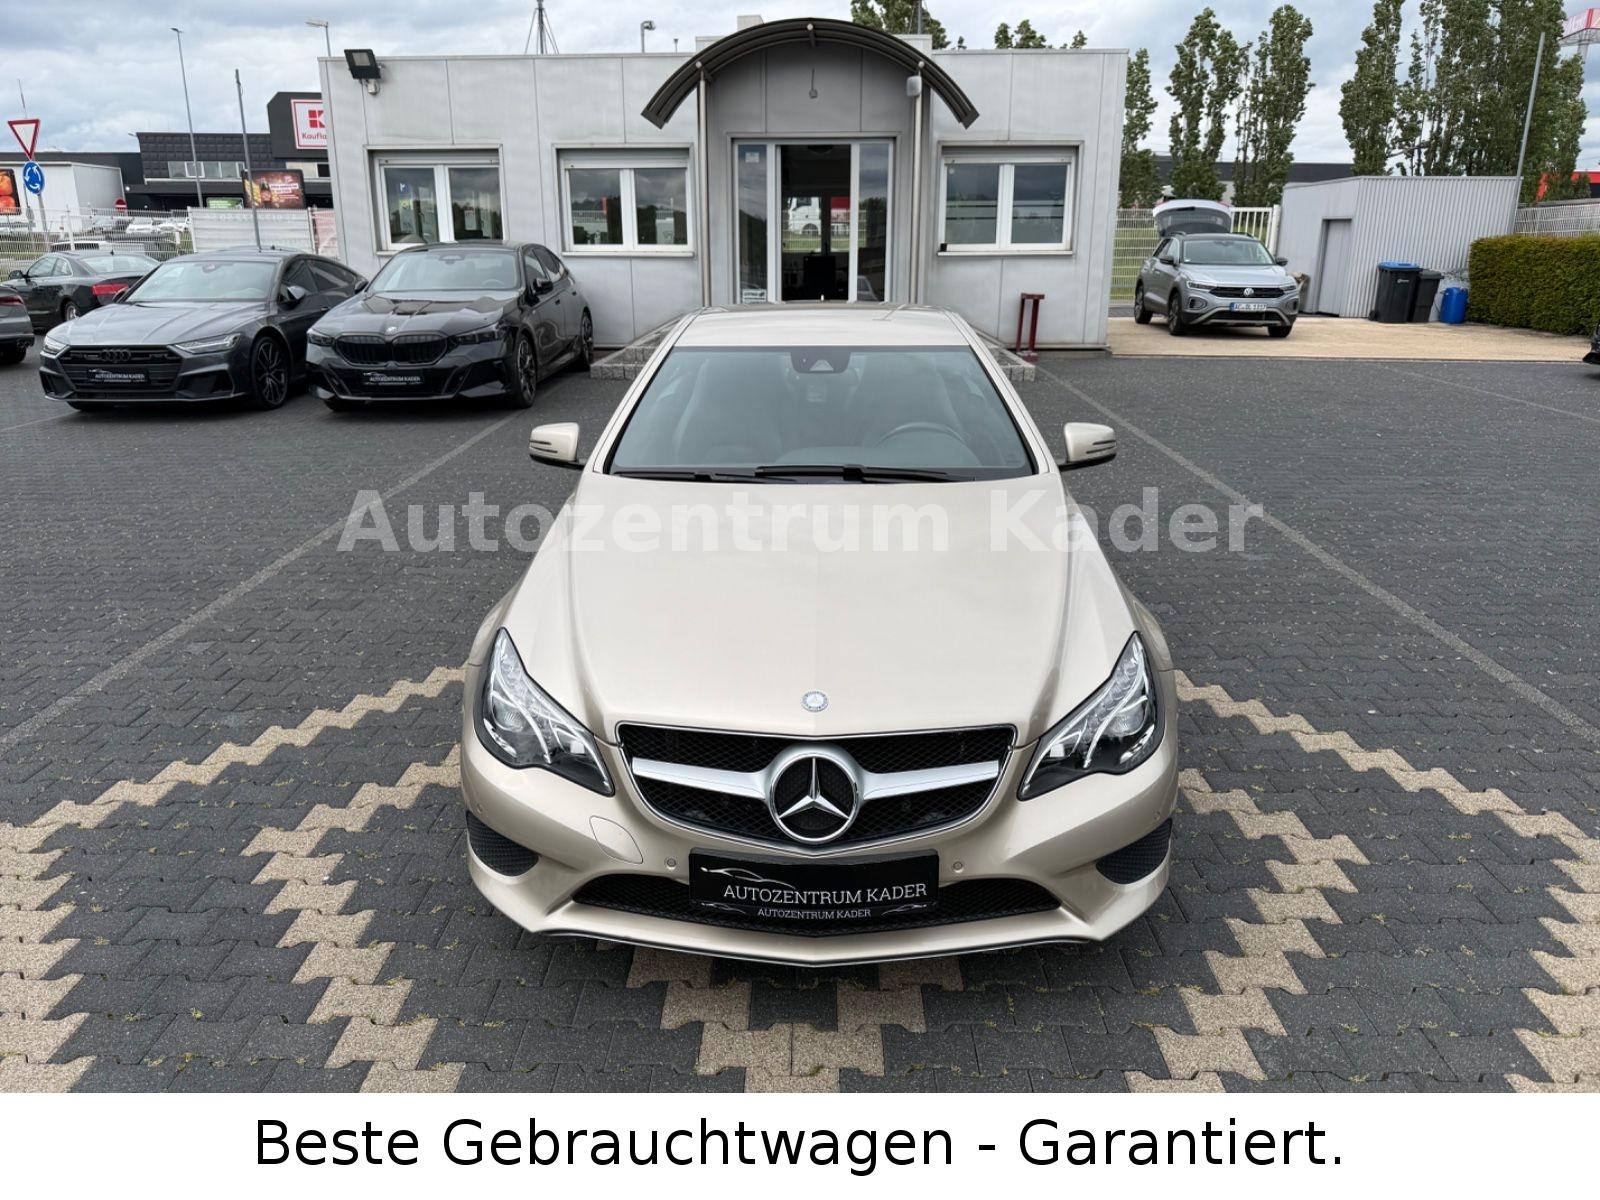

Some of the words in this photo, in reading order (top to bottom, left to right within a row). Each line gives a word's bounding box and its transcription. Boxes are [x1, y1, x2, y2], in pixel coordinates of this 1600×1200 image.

[723, 884, 863, 905] AUTOZENTRUM
[866, 883, 928, 903] KADER
[757, 908, 836, 920] AUTOZENTRUM
[836, 908, 872, 919] KADER
